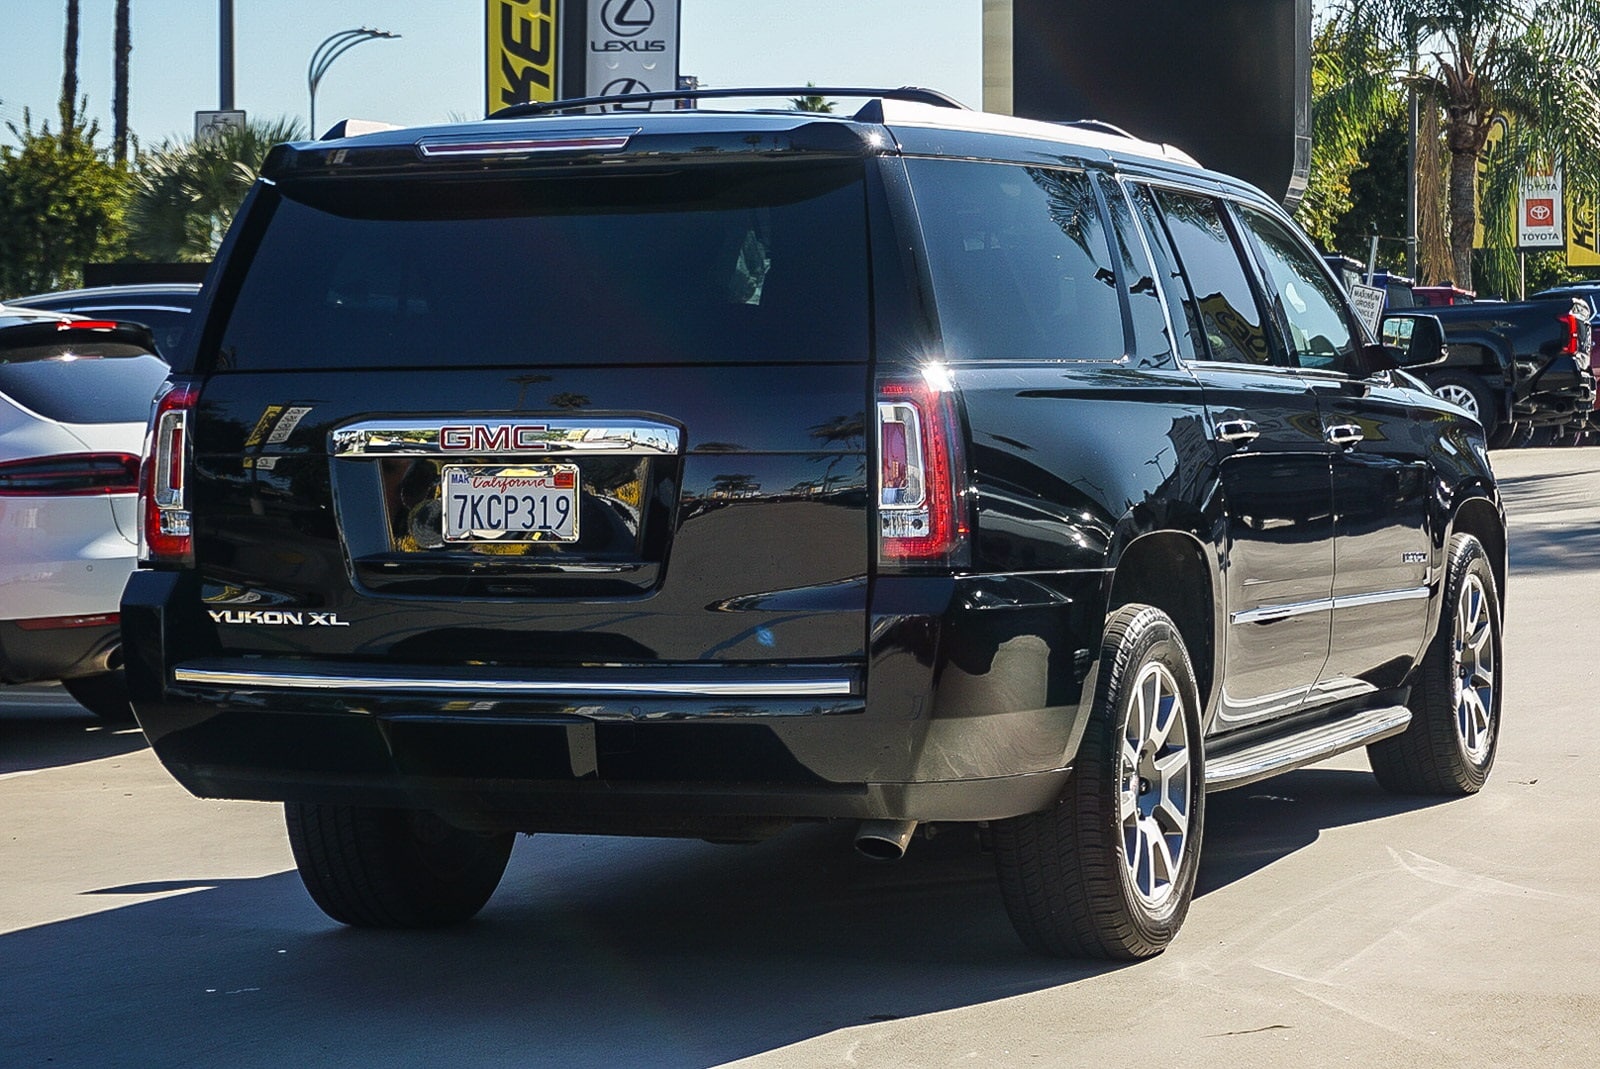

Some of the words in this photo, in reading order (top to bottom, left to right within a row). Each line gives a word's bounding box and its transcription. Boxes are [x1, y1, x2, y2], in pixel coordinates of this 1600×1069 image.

[591, 40, 666, 52] LEXUS
[1521, 233, 1559, 242] TOYOTA
[1354, 290, 1380, 301] MAXIMUM
[440, 425, 549, 451] GMC
[472, 476, 555, 494] California
[453, 495, 570, 530] 7KCP319
[208, 610, 303, 626] YUKON
[308, 612, 350, 627] XL
